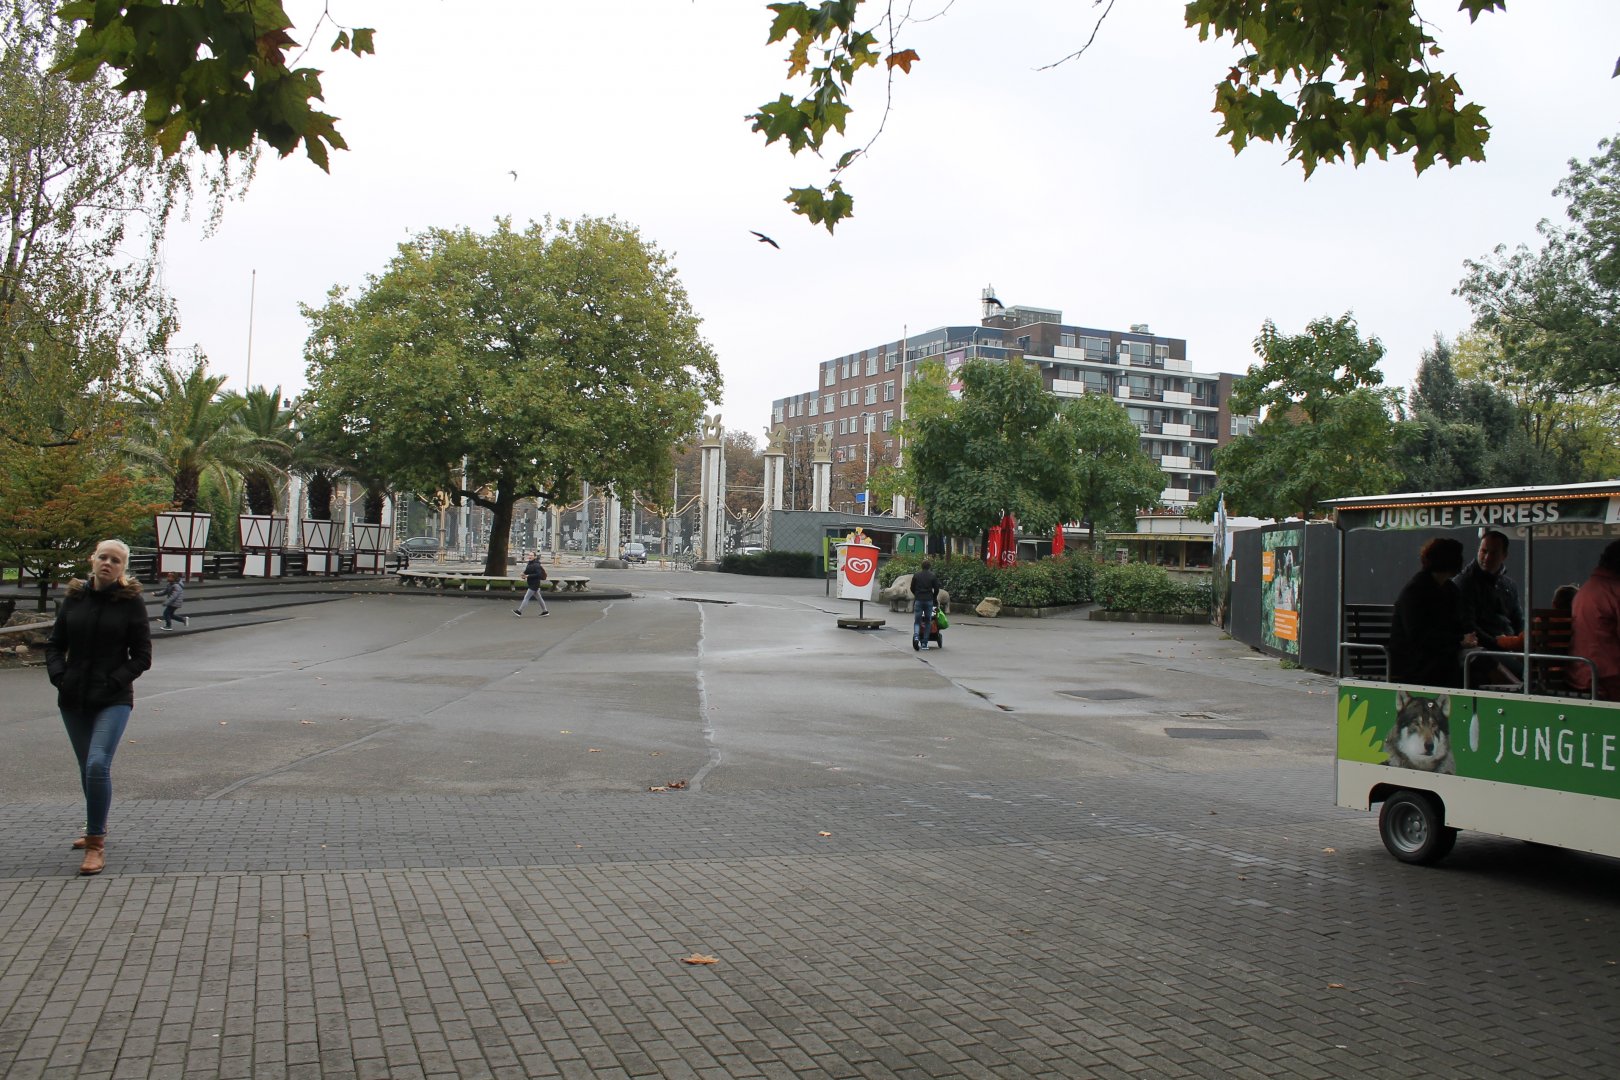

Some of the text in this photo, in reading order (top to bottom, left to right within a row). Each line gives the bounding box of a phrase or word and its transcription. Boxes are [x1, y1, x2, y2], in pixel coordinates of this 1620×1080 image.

[1375, 502, 1560, 528] JUNGLE EXPRESS
[1495, 723, 1616, 771] JUNGLE
